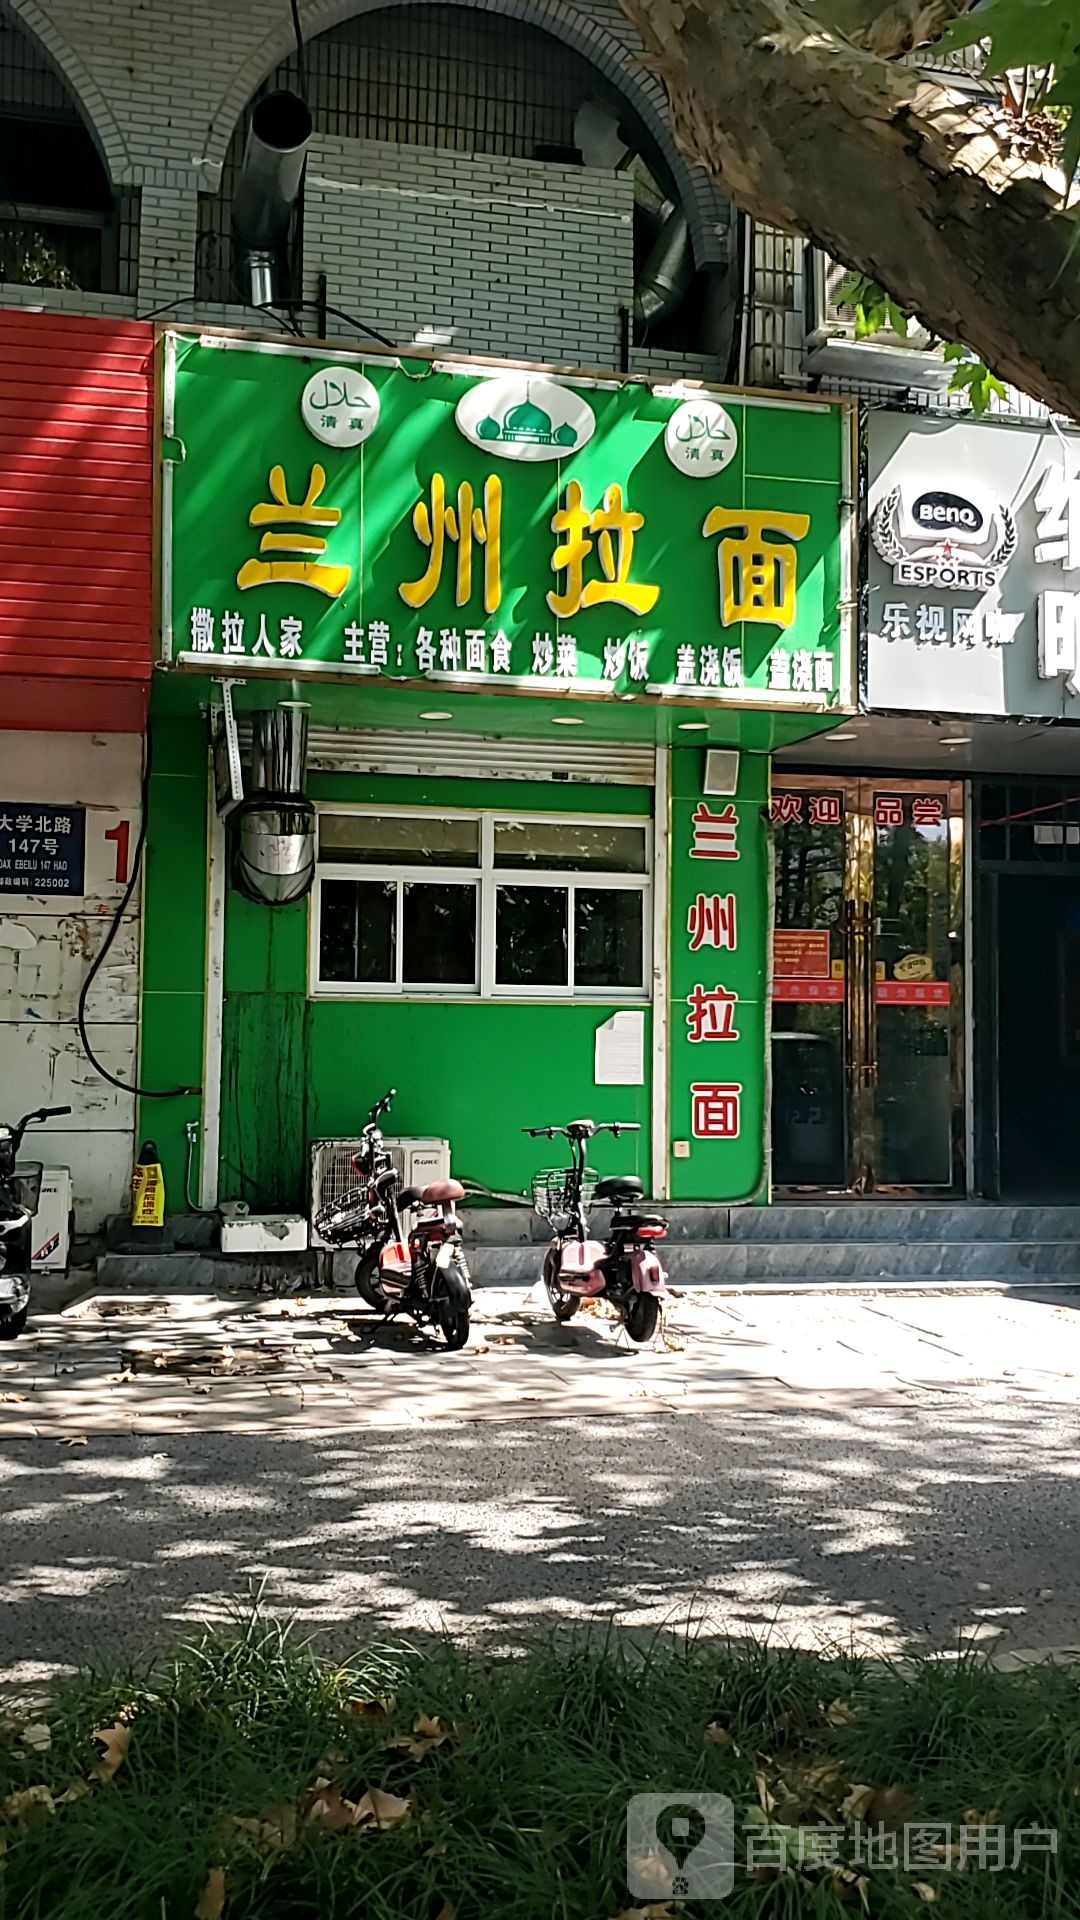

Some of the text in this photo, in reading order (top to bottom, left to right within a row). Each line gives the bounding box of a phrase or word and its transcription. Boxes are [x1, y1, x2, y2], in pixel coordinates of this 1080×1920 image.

[309, 380, 371, 410] حلال
[320, 414, 365, 431] 清真
[675, 414, 731, 442] حلال
[685, 446, 725, 463] 清真
[919, 503, 977, 527] BenQ
[236, 463, 811, 628] 兰州拉面
[901, 564, 996, 587] ESPORTS
[190, 607, 303, 657] 撒拉人家
[532, 632, 577, 677] 炒菜
[603, 637, 649, 682] 炒饭
[676, 643, 744, 688] 盖浇饭
[769, 647, 834, 692] 盖浇面
[770, 793, 944, 828] 欢迎 品尝
[0, 814, 72, 834] 大学北路
[9, 838, 59, 855] 147号
[687, 803, 742, 1139] 兰州拉面
